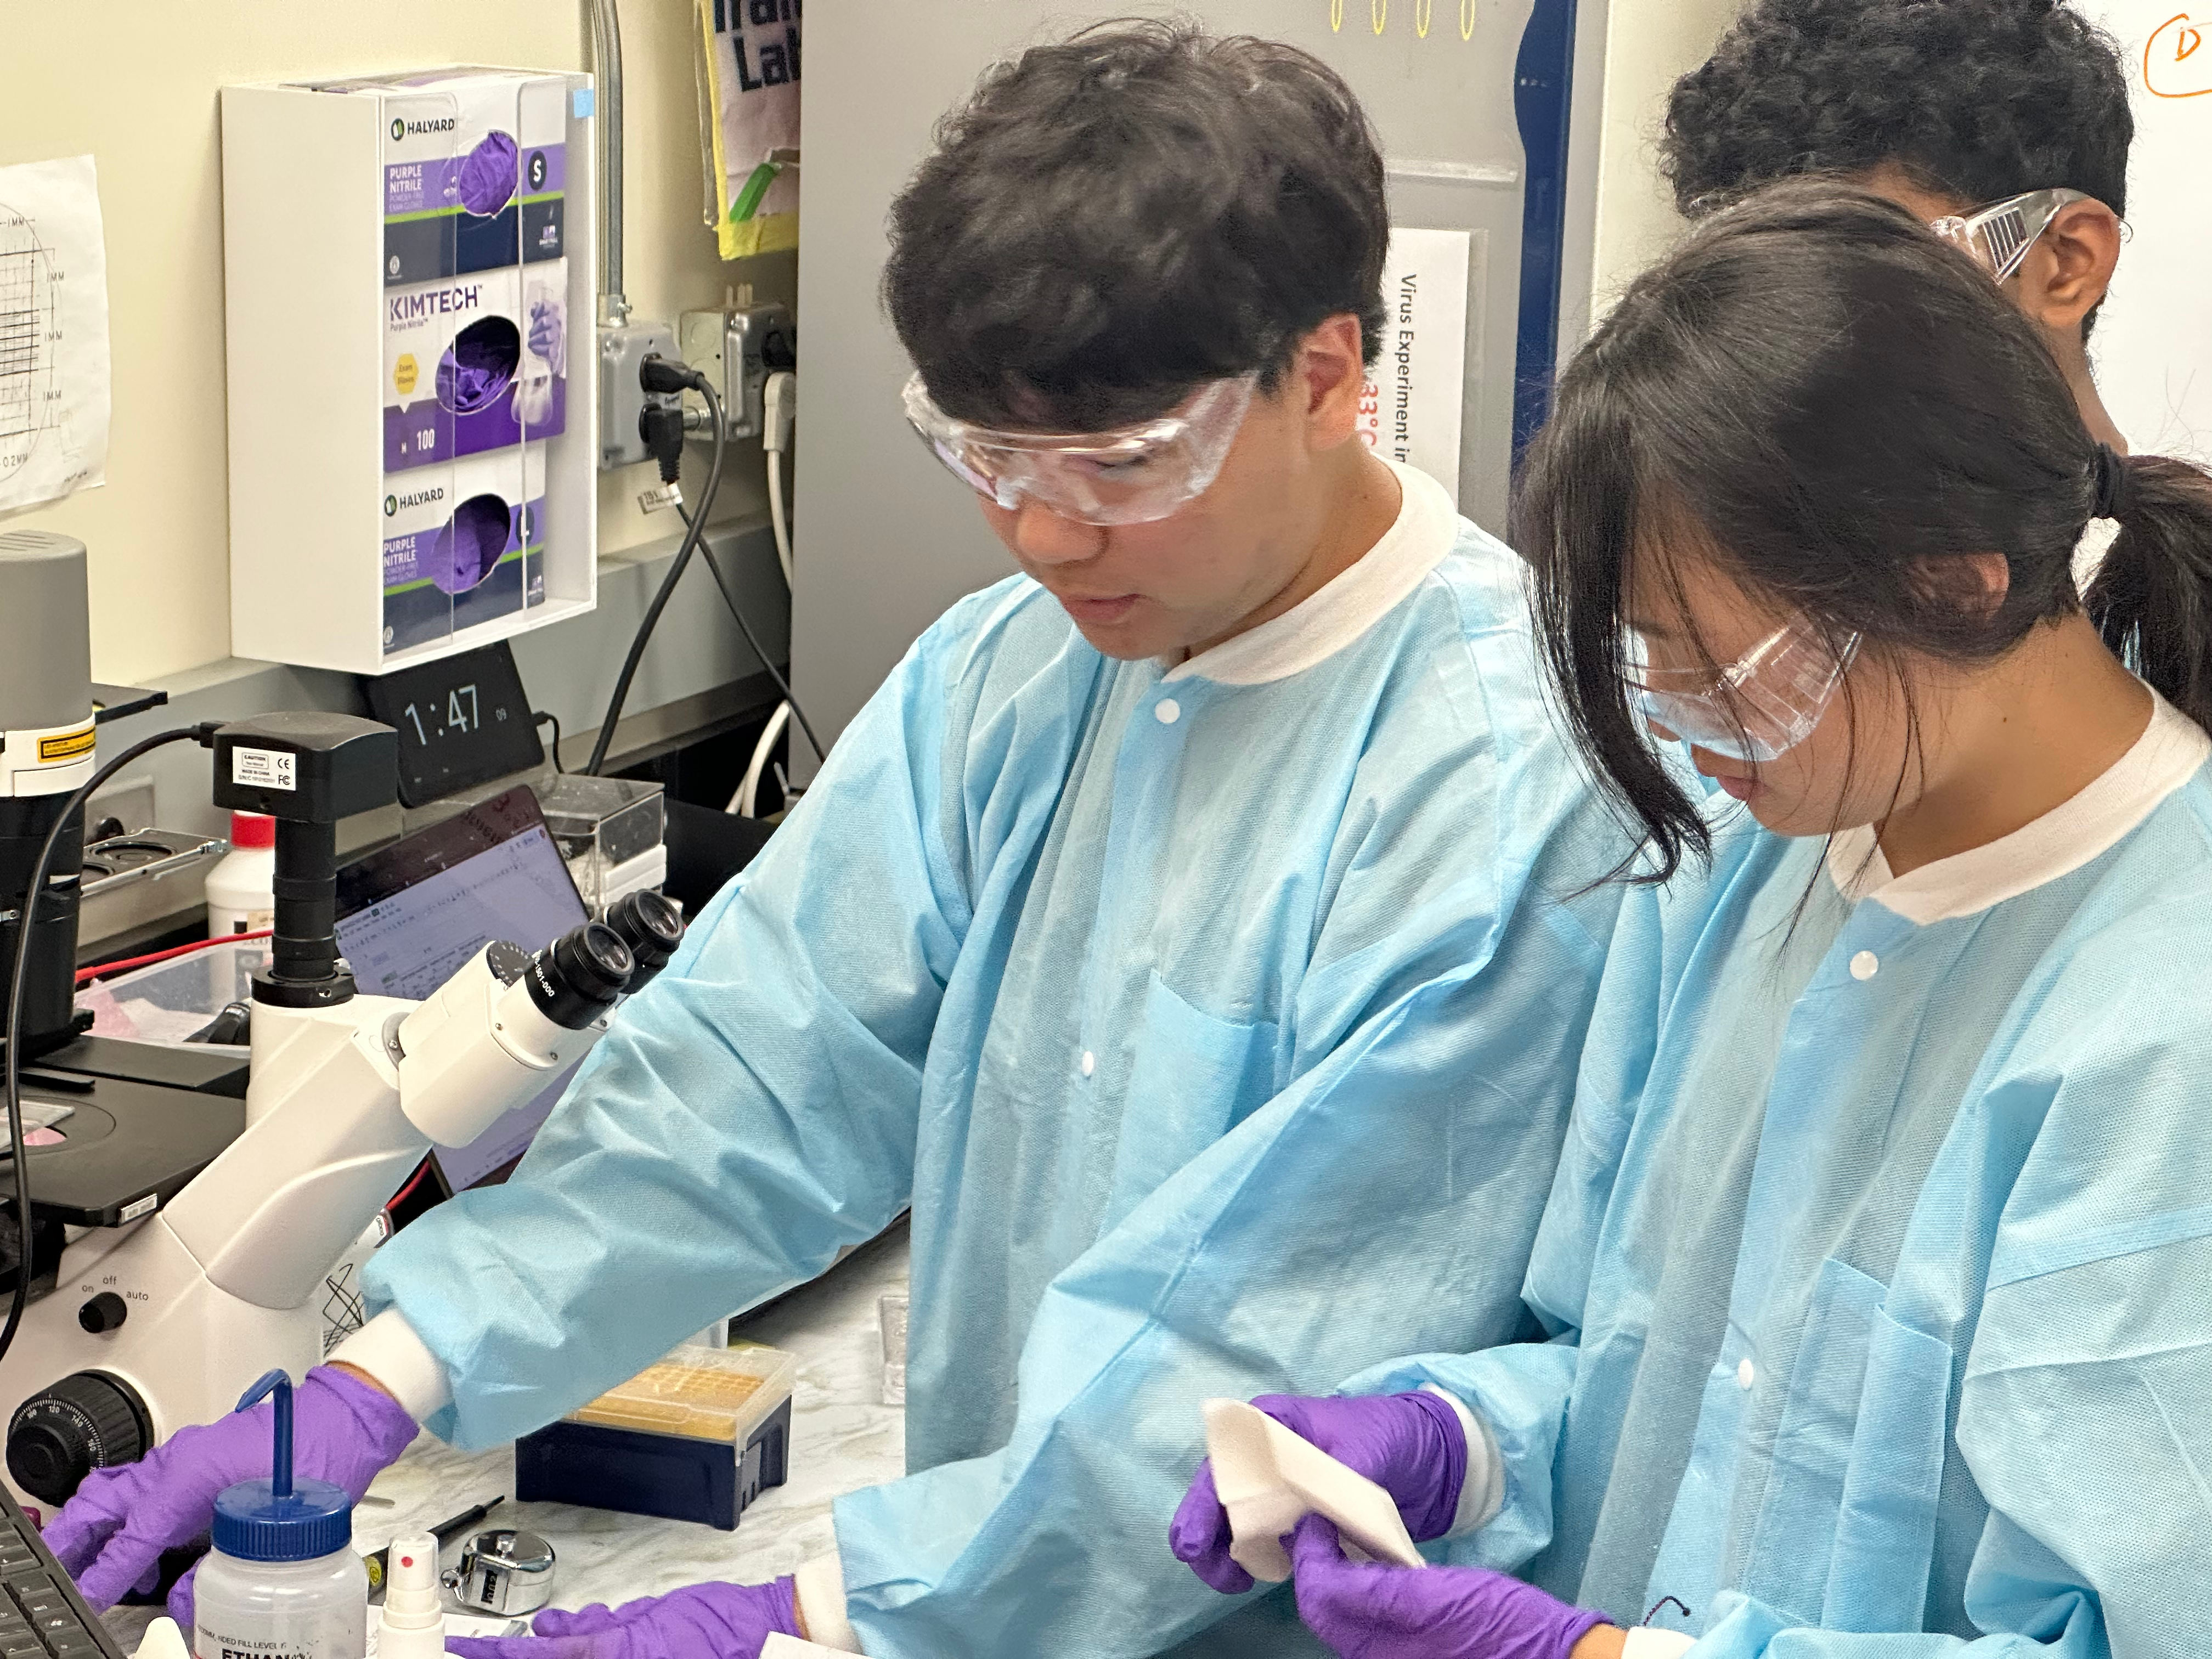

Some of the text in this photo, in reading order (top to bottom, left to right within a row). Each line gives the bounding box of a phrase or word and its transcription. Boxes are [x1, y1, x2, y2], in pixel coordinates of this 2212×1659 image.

[407, 118, 455, 135] HALYARD
[390, 165, 422, 180] PURPLE
[533, 160, 542, 182] S
[390, 178, 422, 193] NITRILE
[1400, 274, 1417, 324] Virus
[1394, 330, 1415, 441] Experiment
[417, 428, 435, 451] 100
[399, 487, 444, 509] HALYARD
[383, 536, 416, 554] PURPLE
[383, 549, 416, 567] NITRILE
[404, 683, 479, 746] 1:47
[82, 1276, 149, 1301] on off auto
[27, 1408, 37, 1419] 100
[48, 1405, 60, 1414] 120
[71, 1414, 83, 1428] 140
[238, 1639, 252, 1648] FILL
[254, 1641, 278, 1650] LEVEL
